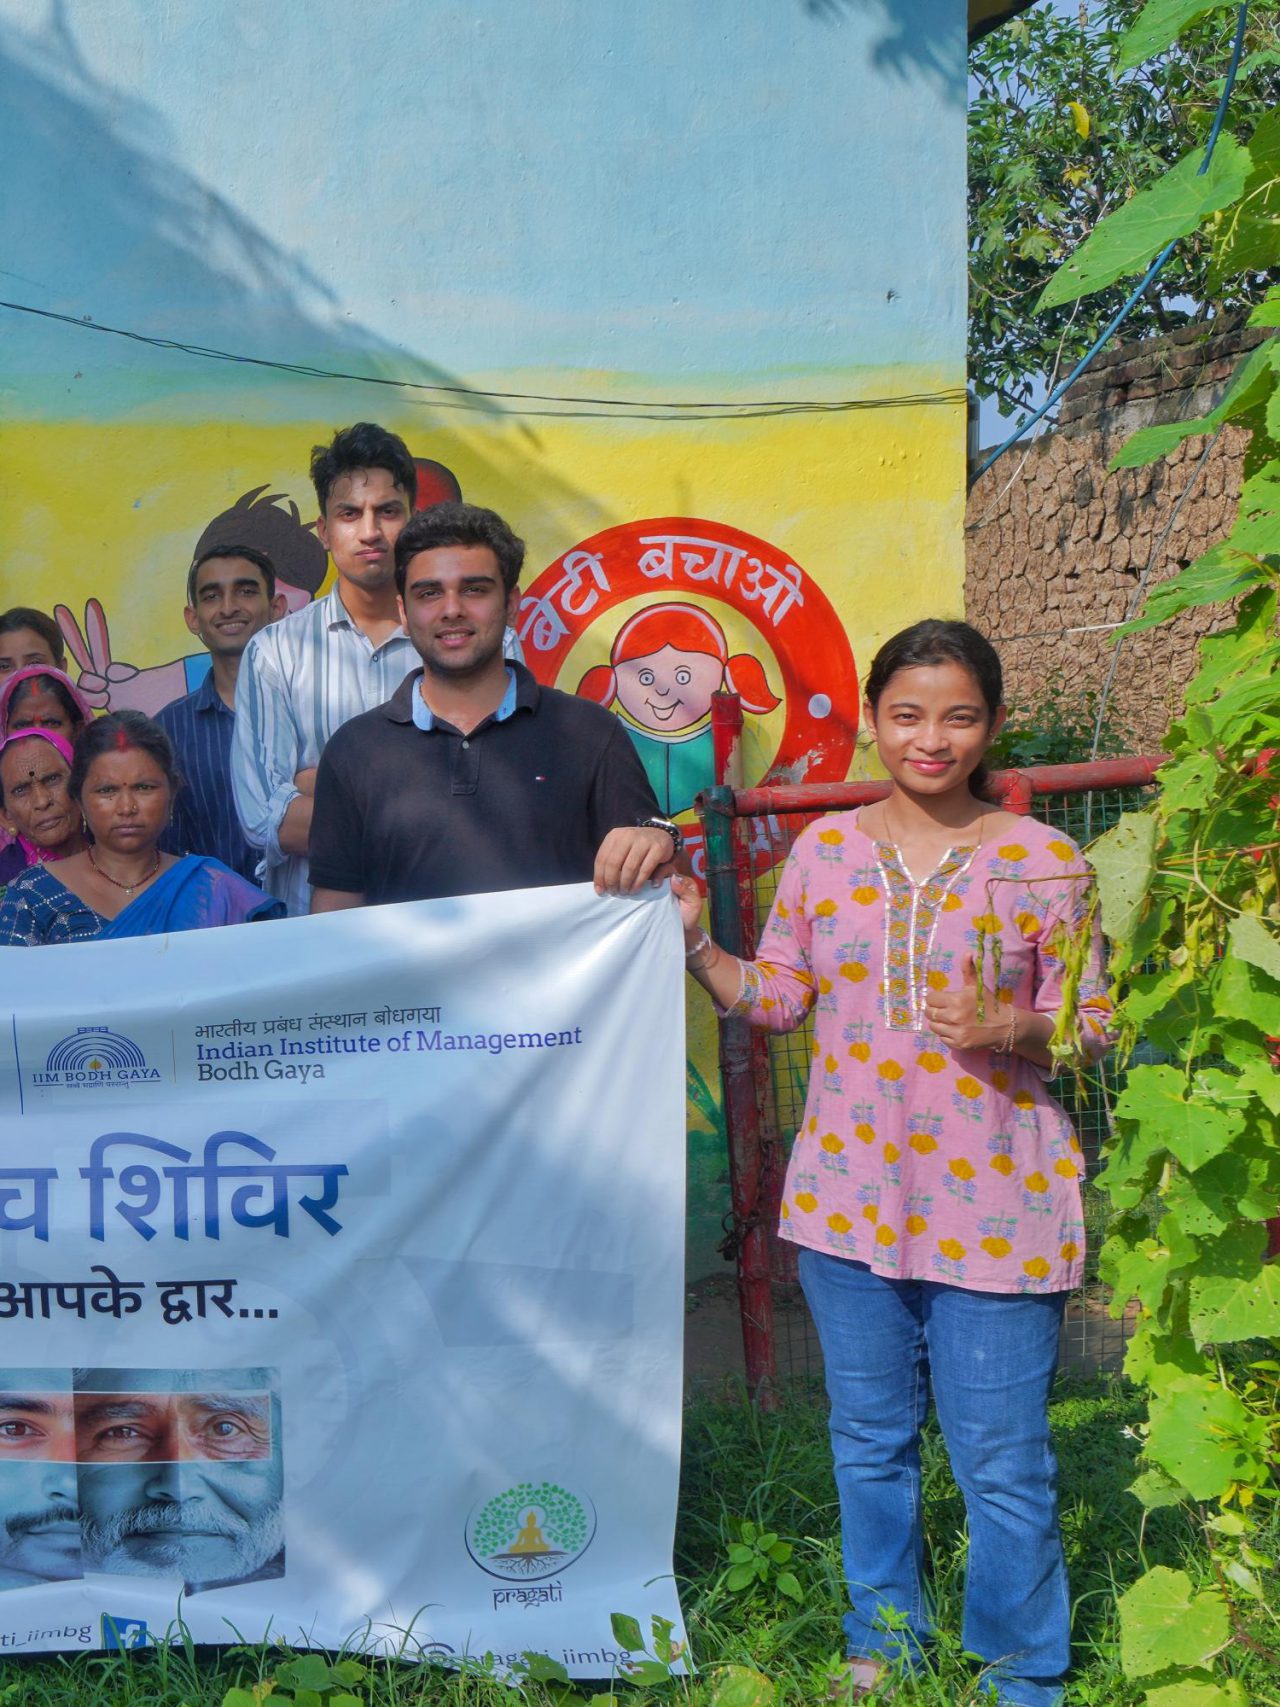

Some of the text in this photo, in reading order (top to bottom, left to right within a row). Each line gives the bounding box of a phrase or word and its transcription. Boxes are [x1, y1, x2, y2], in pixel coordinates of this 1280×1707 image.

[520, 535, 804, 651] बेटी बचाओ
[194, 1005, 442, 1039] भारतीय प्रबंध संस्थान बोधगया
[196, 1026, 583, 1061] Indian Institute of Management
[32, 1068, 161, 1083] IIM BODH GAYA
[197, 1060, 326, 1084] Bodh Gaya
[80, 1130, 350, 1242] शिविर
[156, 1278, 279, 1325] द्वार...
[492, 1580, 563, 1610] pragati
